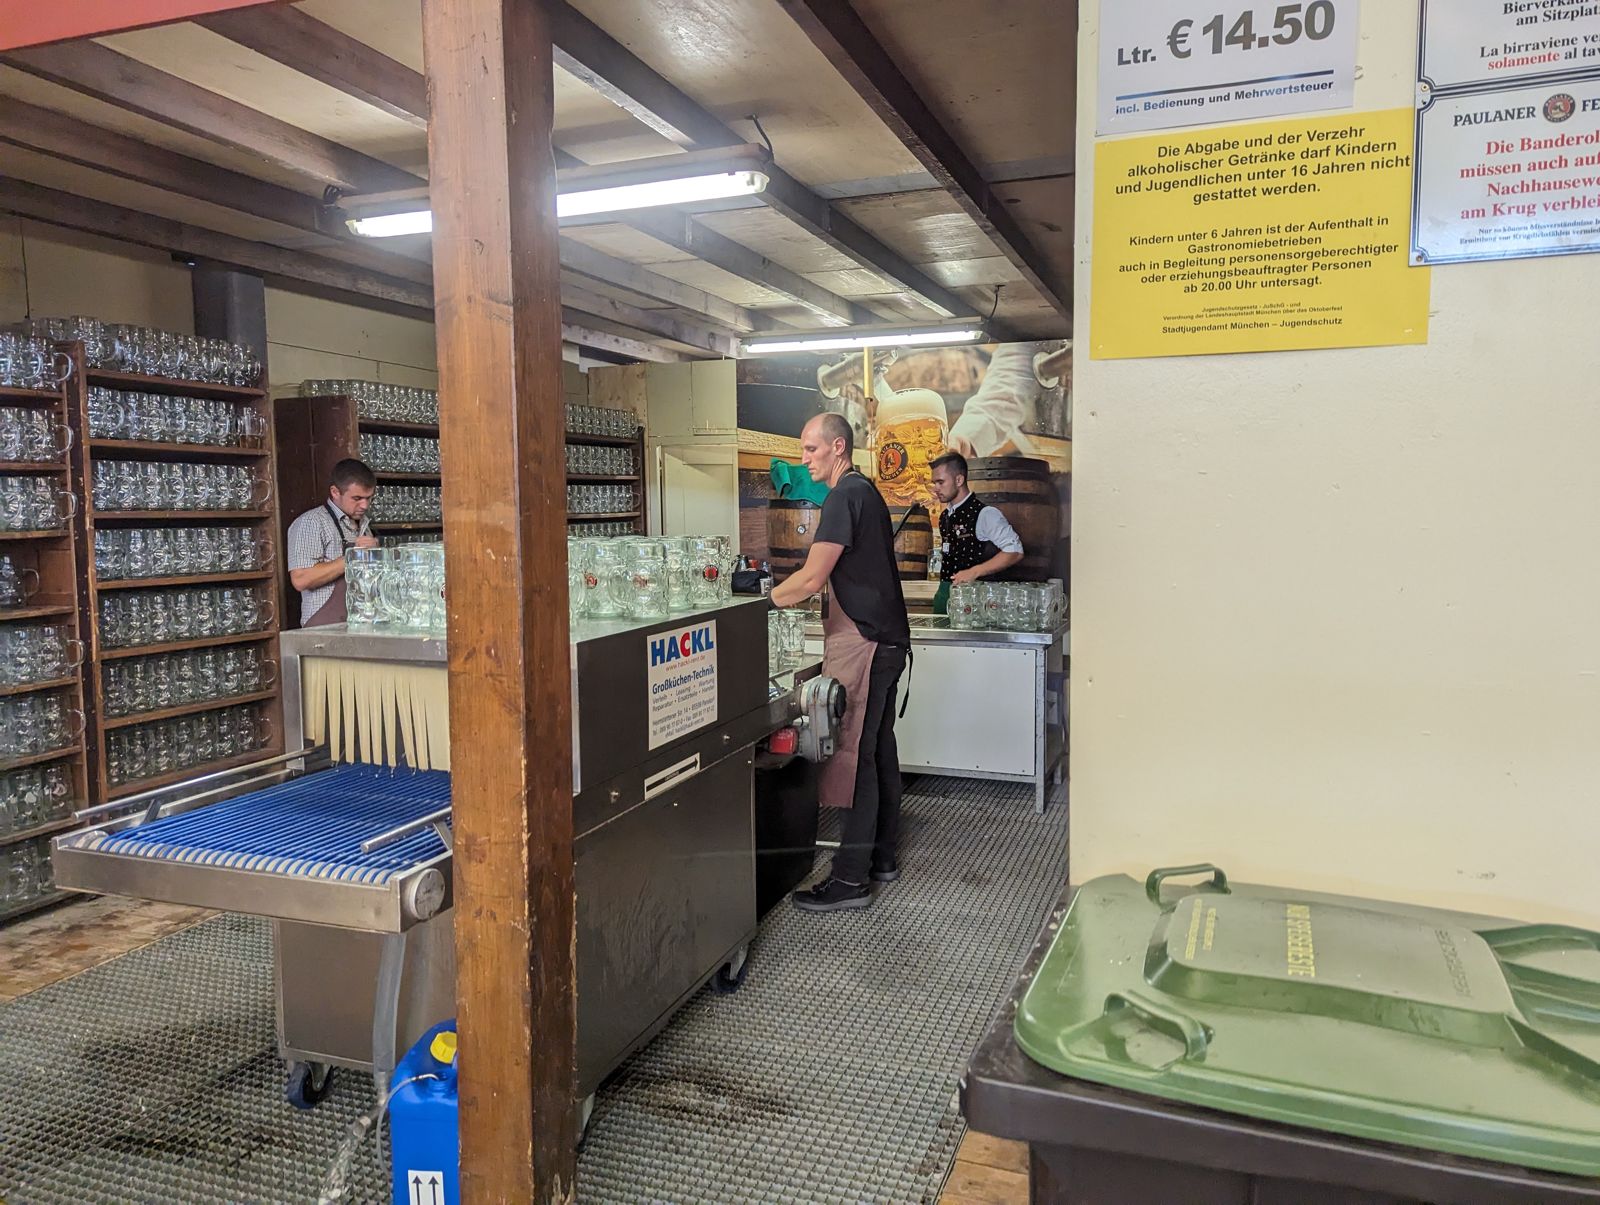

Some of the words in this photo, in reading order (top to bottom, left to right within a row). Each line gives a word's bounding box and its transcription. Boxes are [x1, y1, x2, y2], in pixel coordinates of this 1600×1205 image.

[1516, 15, 1538, 26] am
[1542, 5, 1600, 23] Sitzplat
[1117, 47, 1157, 66] Ltr.
[1167, 19, 1194, 59] €
[1202, 0, 1336, 54] 14.50
[1480, 46, 1499, 58] La
[1503, 36, 1578, 54] birraviene
[1583, 33, 1600, 43] ve
[1488, 51, 1560, 70] solamente
[1564, 47, 1577, 60] al
[1116, 103, 1140, 114] incl.
[1143, 94, 1205, 111] Bedienung
[1209, 91, 1230, 104] und
[1235, 80, 1334, 99] Mehrwertsteuer
[1453, 106, 1536, 127] PAULANER
[1158, 145, 1180, 158] Die
[1184, 139, 1239, 155] Abgabe
[1244, 134, 1273, 148] und
[1277, 133, 1302, 145] der
[1307, 126, 1365, 142] Verzehr
[1486, 140, 1514, 155] Die
[1128, 158, 1223, 177] alkoholischer
[1228, 150, 1295, 167] Getränke
[1300, 145, 1331, 160] darf
[1335, 141, 1397, 157] Kindern
[1460, 163, 1521, 178] müssen
[1527, 155, 1568, 172] auch
[1115, 181, 1141, 195] und
[1145, 173, 1242, 193] Jugendlichen
[1247, 168, 1286, 181] unter
[1291, 164, 1308, 177] 16
[1312, 161, 1365, 175] Jahren
[1371, 155, 1410, 171] nicht
[1193, 186, 1257, 206] gestattet
[1261, 182, 1321, 196] werden.
[1460, 208, 1486, 219] am
[1492, 202, 1537, 217] Krug
[1129, 235, 1174, 247] Kindern
[1177, 231, 1208, 242] unter
[1211, 229, 1218, 239] 6
[1221, 227, 1262, 239] Jahren
[1266, 224, 1281, 235] ist
[1284, 223, 1305, 234] der
[1308, 217, 1373, 232] Aufenthalt
[1377, 216, 1389, 226] in
[1188, 235, 1322, 254] Gastronomiebetrieben
[1119, 262, 1146, 272] auch
[1149, 261, 1159, 270] in
[1163, 257, 1225, 270] Begleitung
[1229, 243, 1399, 265] personensorgeberechtigter
[1141, 273, 1166, 284] oder
[1169, 263, 1308, 281] erziehungsbeauftragter
[1312, 260, 1372, 272] Personen
[1183, 283, 1198, 293] ab
[1201, 281, 1232, 292] 20.00
[1235, 279, 1257, 289] Uhr
[1261, 275, 1322, 288] untersagt.
[1201, 304, 1258, 313] Jugendschutzgesetz
[1162, 323, 1228, 334] Stadtjugendamt
[1230, 321, 1270, 330] München
[1280, 317, 1343, 328] Jugendschutz
[651, 627, 714, 667] HACKL
[653, 665, 714, 695] Großküchen-Technik
